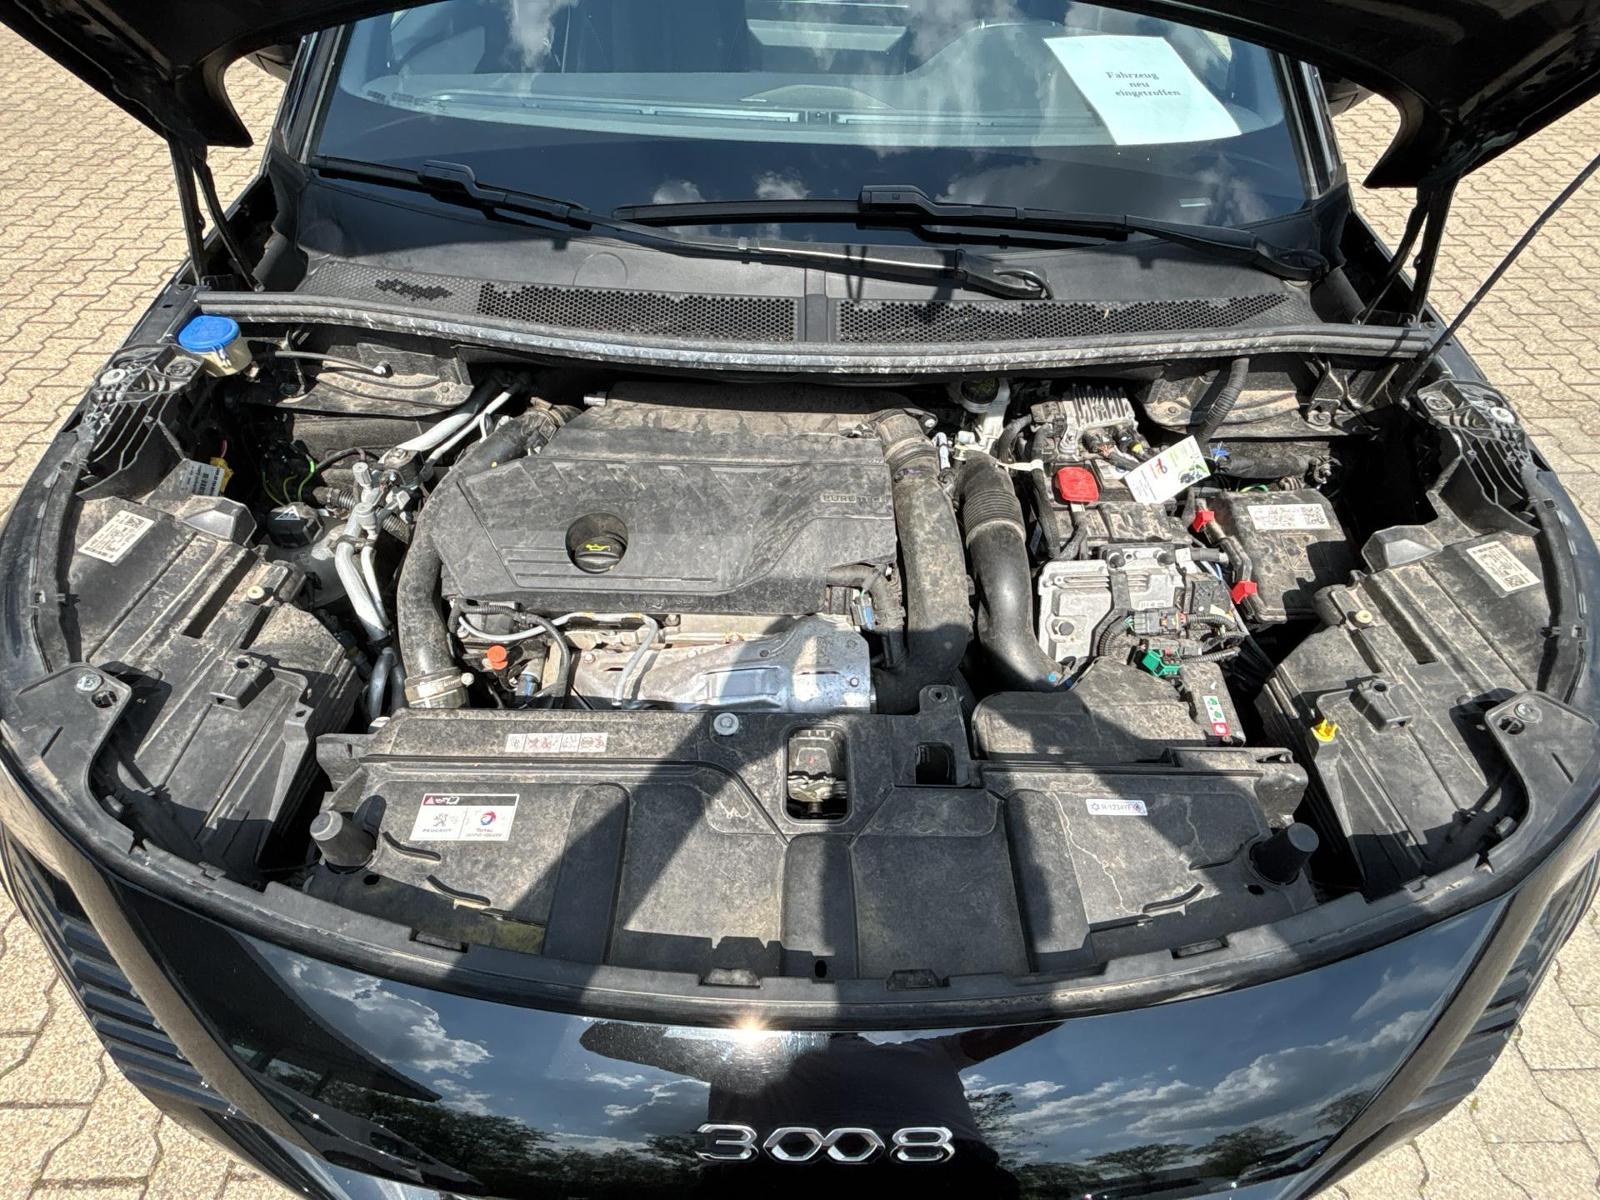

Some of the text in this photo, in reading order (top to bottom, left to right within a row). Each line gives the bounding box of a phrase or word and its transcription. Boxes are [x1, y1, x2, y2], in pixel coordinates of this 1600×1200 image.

[1105, 71, 1160, 80] Fahrzeug
[1115, 88, 1181, 98] eingetroffen
[695, 1123, 955, 1164] 3008
